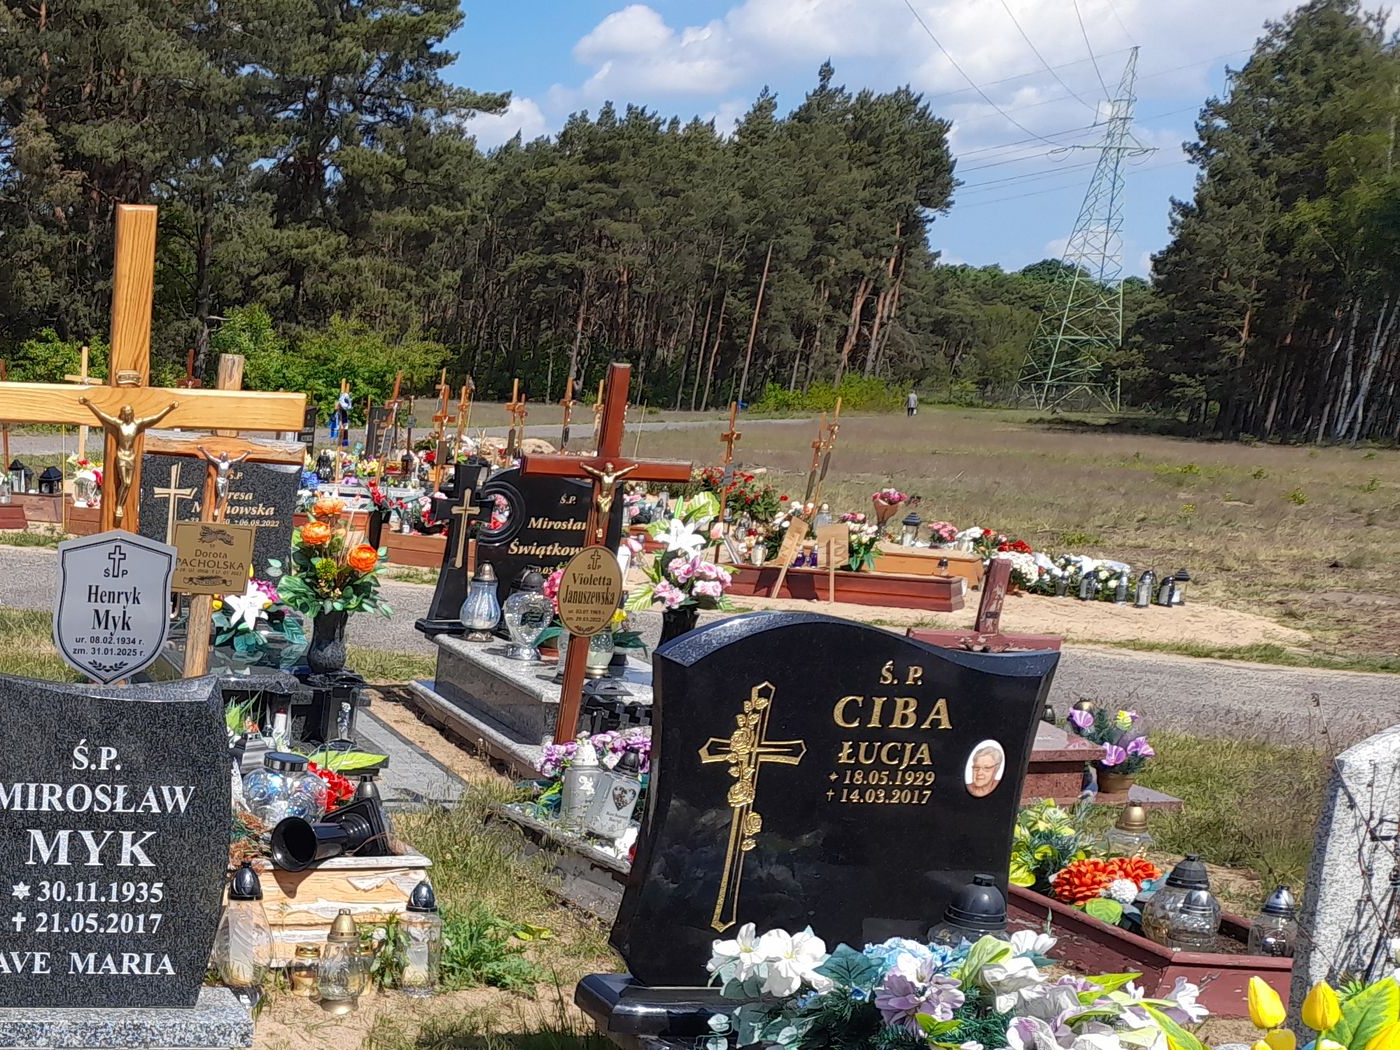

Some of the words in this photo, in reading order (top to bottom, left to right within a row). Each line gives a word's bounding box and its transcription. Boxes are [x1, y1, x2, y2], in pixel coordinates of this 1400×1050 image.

[560, 494, 576, 504] Ś.P.
[195, 549, 228, 559] Dorota
[103, 568, 110, 578] Ś
[121, 570, 128, 578] P
[573, 573, 612, 586] Violetta
[87, 584, 141, 609] Henryk
[563, 585, 615, 606] Januszewska
[91, 607, 132, 636] Myk
[89, 636, 136, 645] 08.02.1934
[91, 648, 137, 657] 31.01.2025
[879, 660, 899, 685] Ś.
[905, 665, 923, 685] P.
[832, 695, 953, 730] CIBA
[72, 739, 122, 771] Ś.P.
[838, 741, 933, 770] ŁUCJA
[843, 770, 936, 786] 18.05.1929
[840, 788, 932, 805] 14.03.2017
[25, 829, 158, 867] MYK
[37, 881, 165, 903] 30.11.1935
[35, 912, 164, 934] 21.05.2017
[68, 952, 177, 976] MARIA
